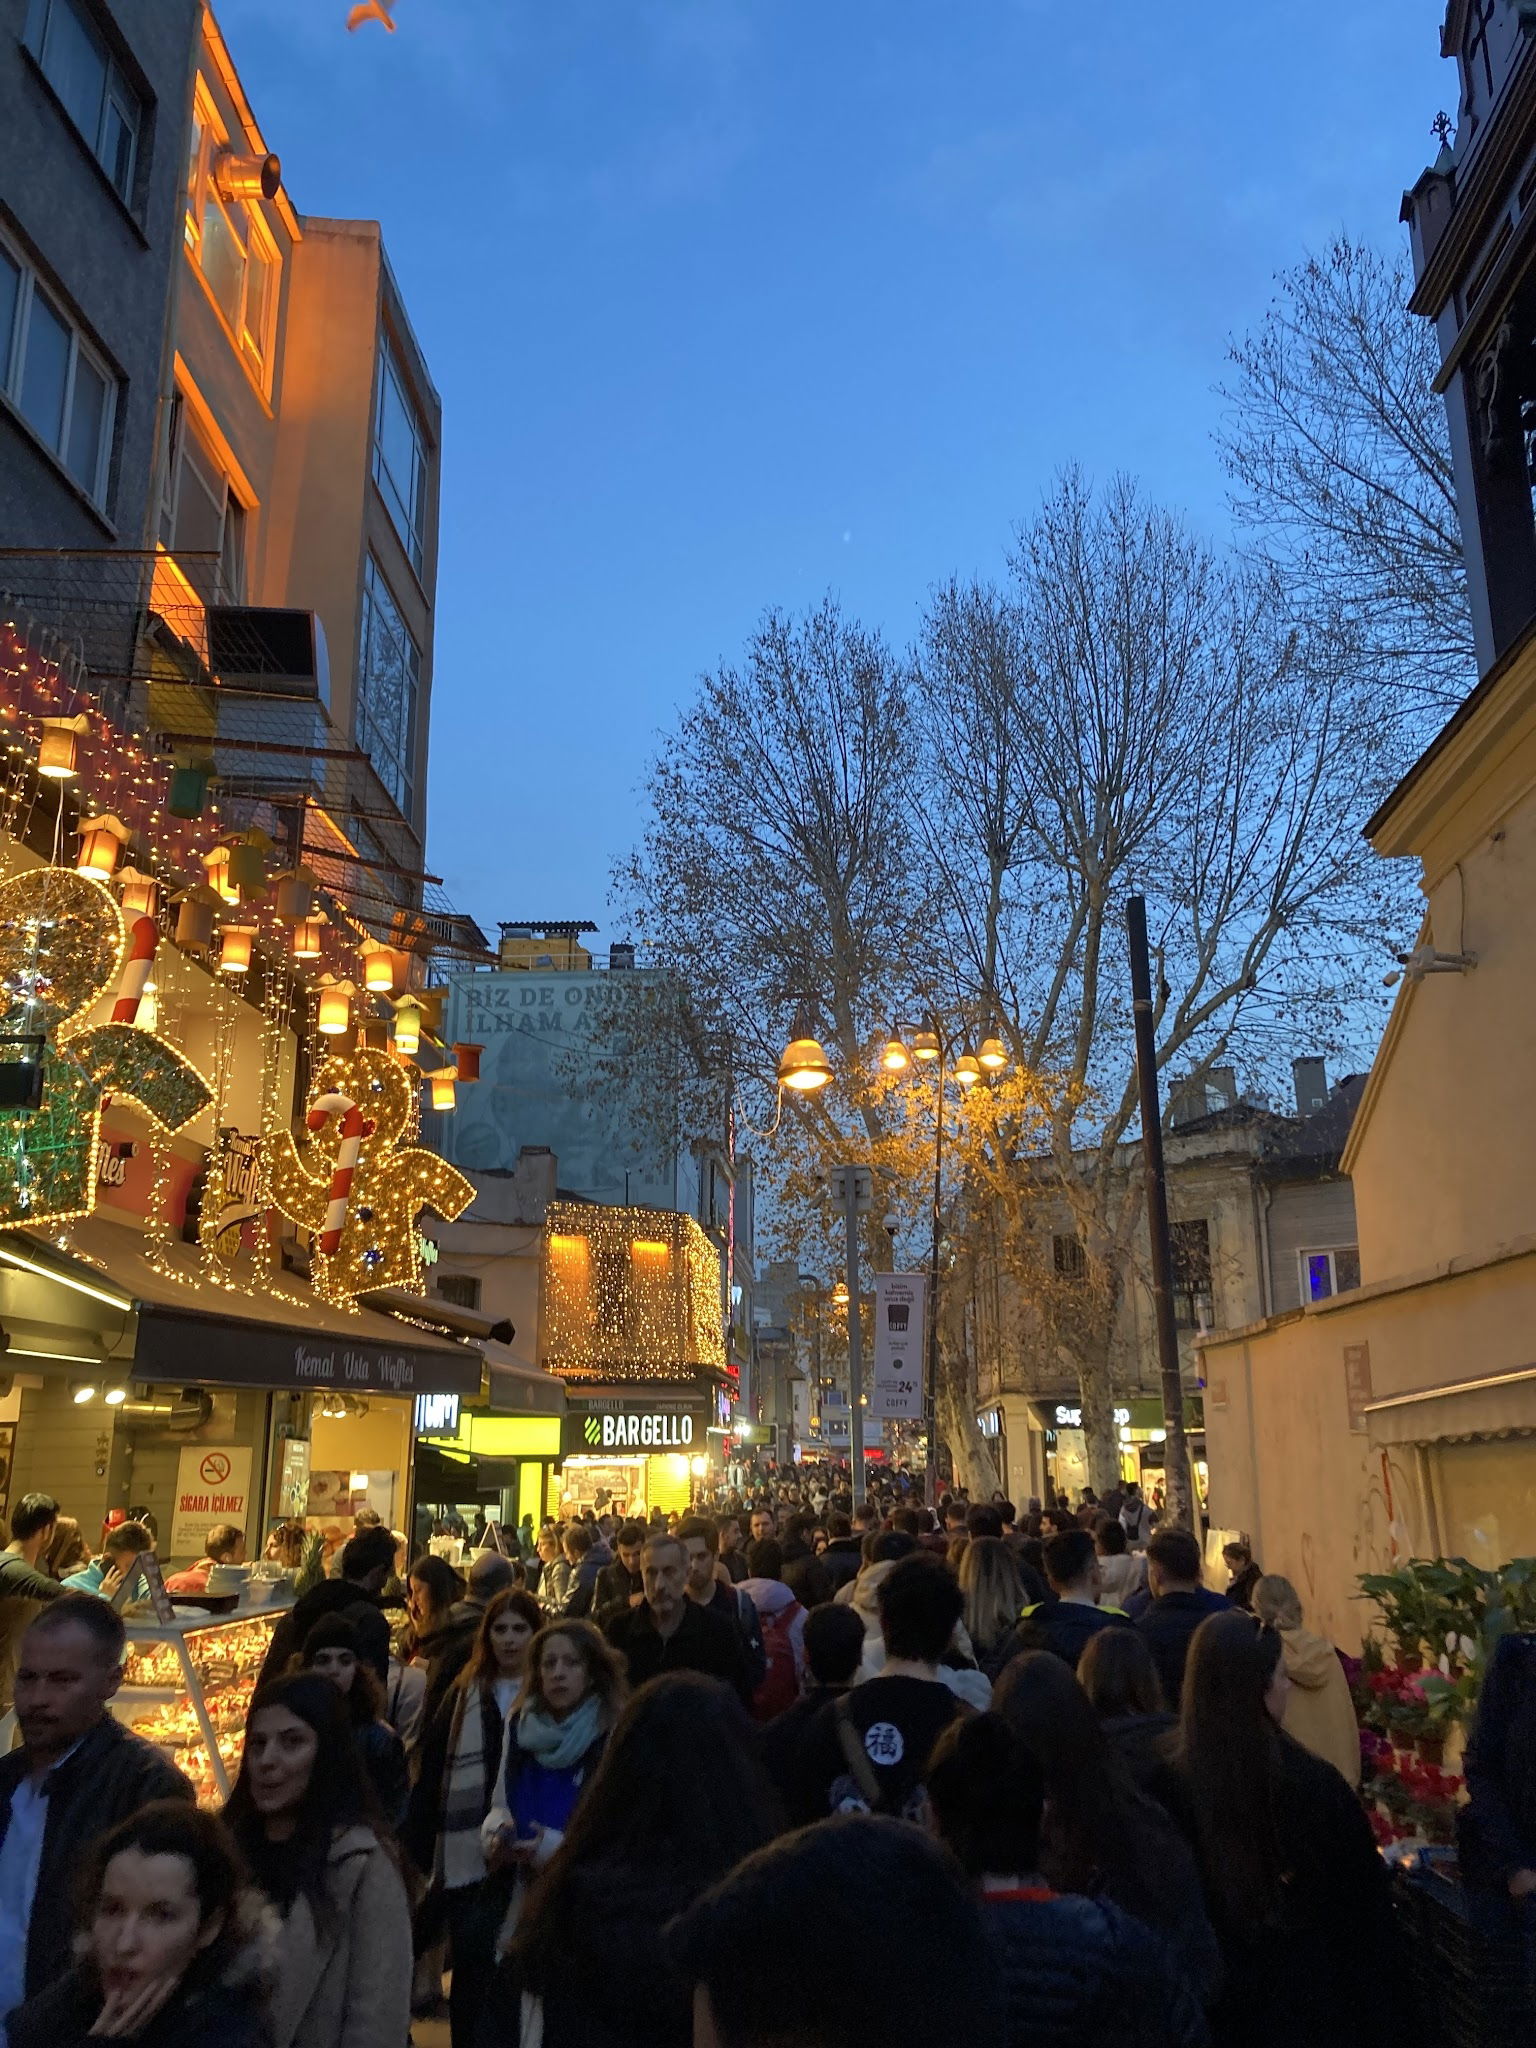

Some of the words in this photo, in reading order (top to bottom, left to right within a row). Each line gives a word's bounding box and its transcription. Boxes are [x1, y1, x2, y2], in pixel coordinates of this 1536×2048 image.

[465, 985, 510, 1008] BİZ
[520, 987, 554, 1006] DE
[465, 1011, 563, 1033] İLHAM
[295, 1346, 335, 1378] Kemal
[344, 1351, 369, 1380] Usta
[899, 1381, 912, 1393] 24
[588, 1400, 624, 1410] BARGELLO
[603, 1415, 693, 1446] BARGELLO
[180, 1493, 209, 1512] SİGARA
